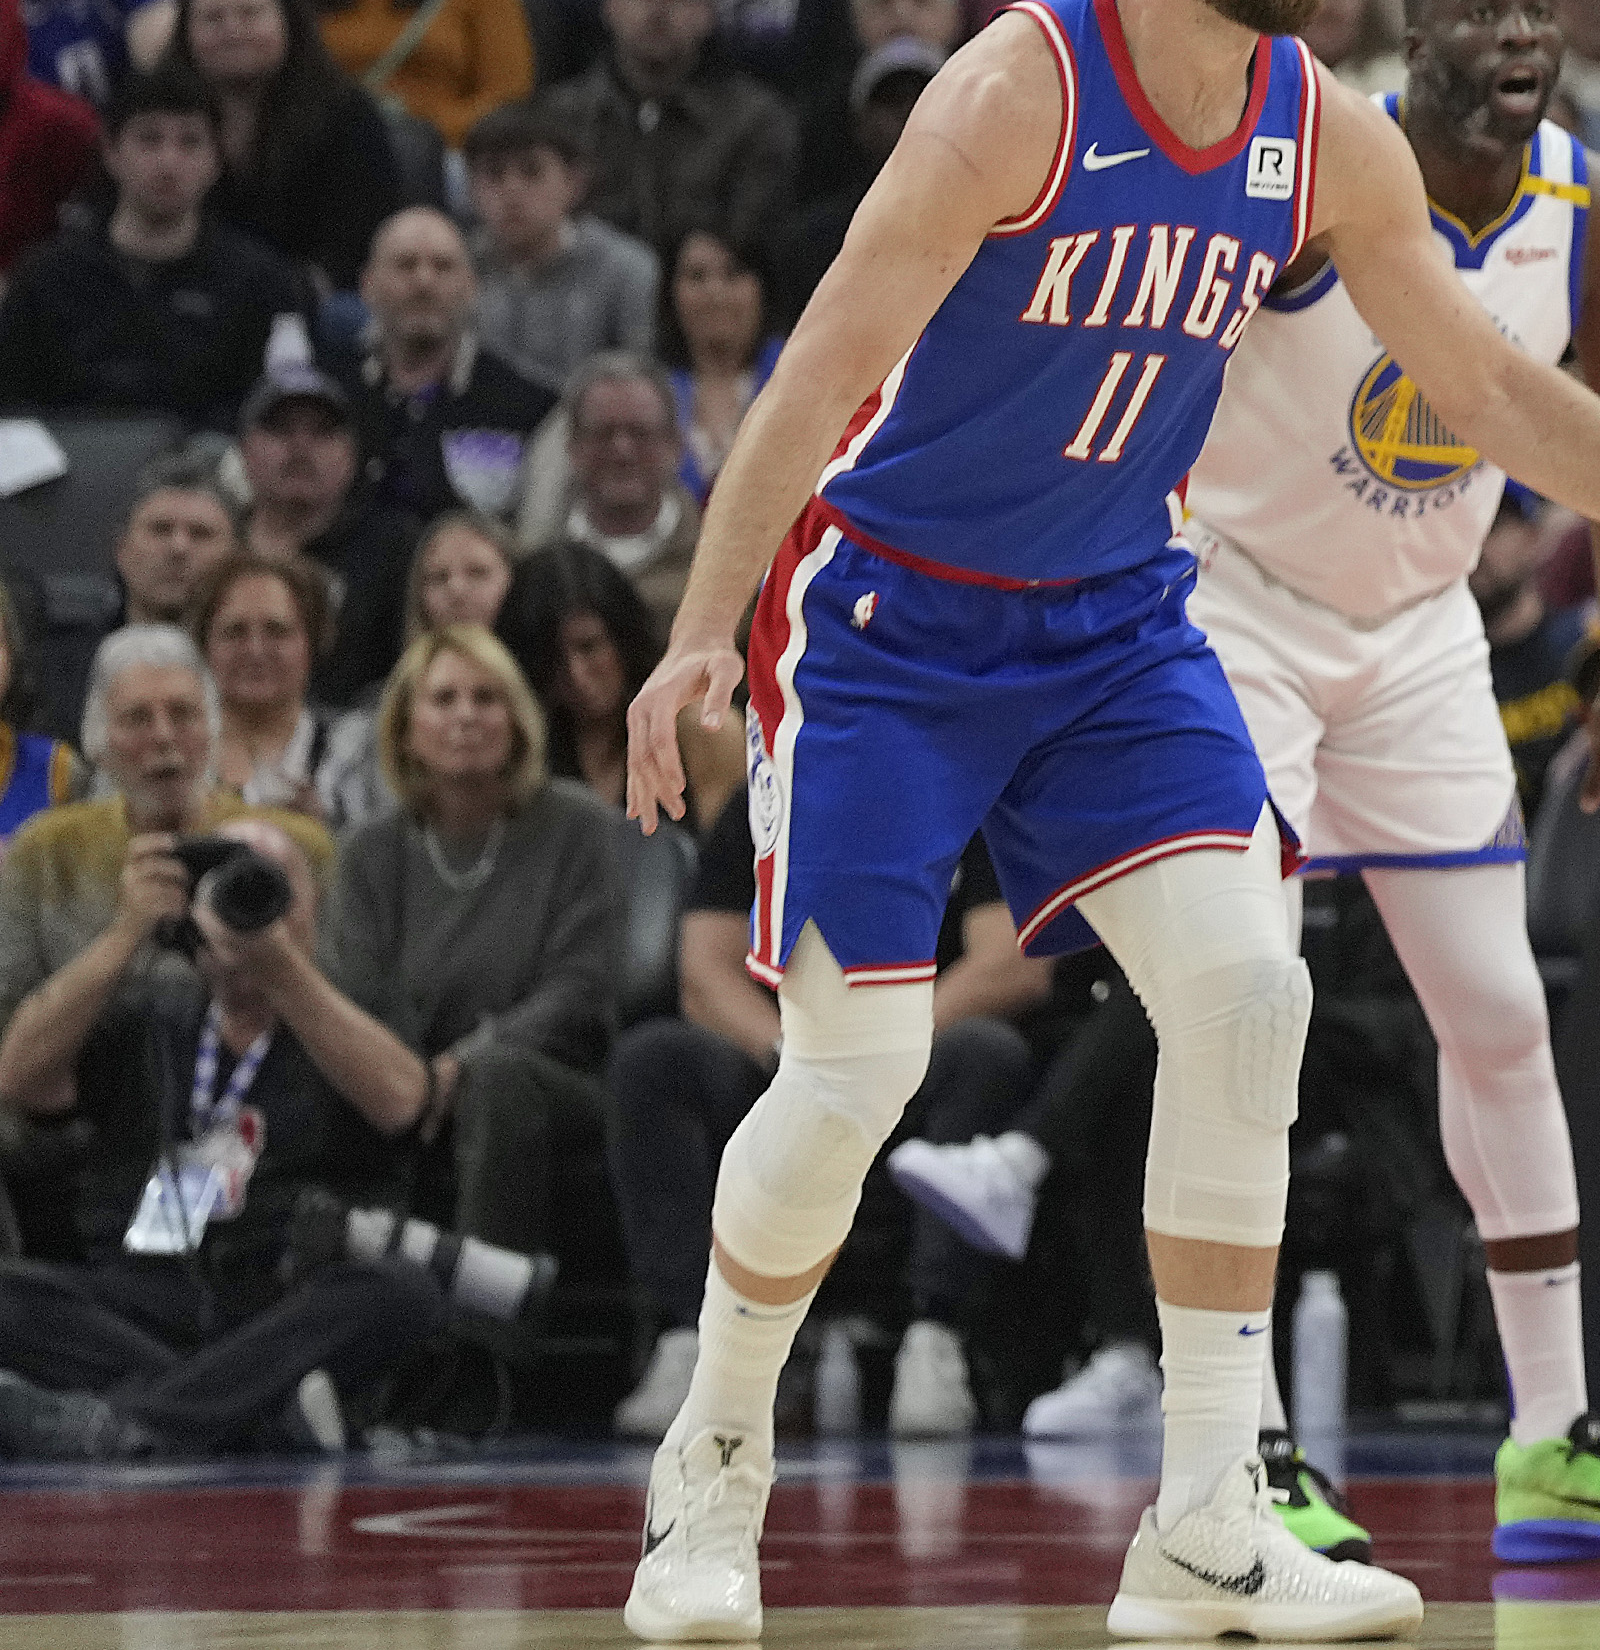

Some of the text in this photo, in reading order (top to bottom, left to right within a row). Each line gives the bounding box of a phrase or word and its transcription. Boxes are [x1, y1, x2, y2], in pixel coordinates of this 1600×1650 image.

[1259, 146, 1283, 175] R
[1019, 224, 1277, 351] KINGS
[1062, 351, 1168, 463] 11
